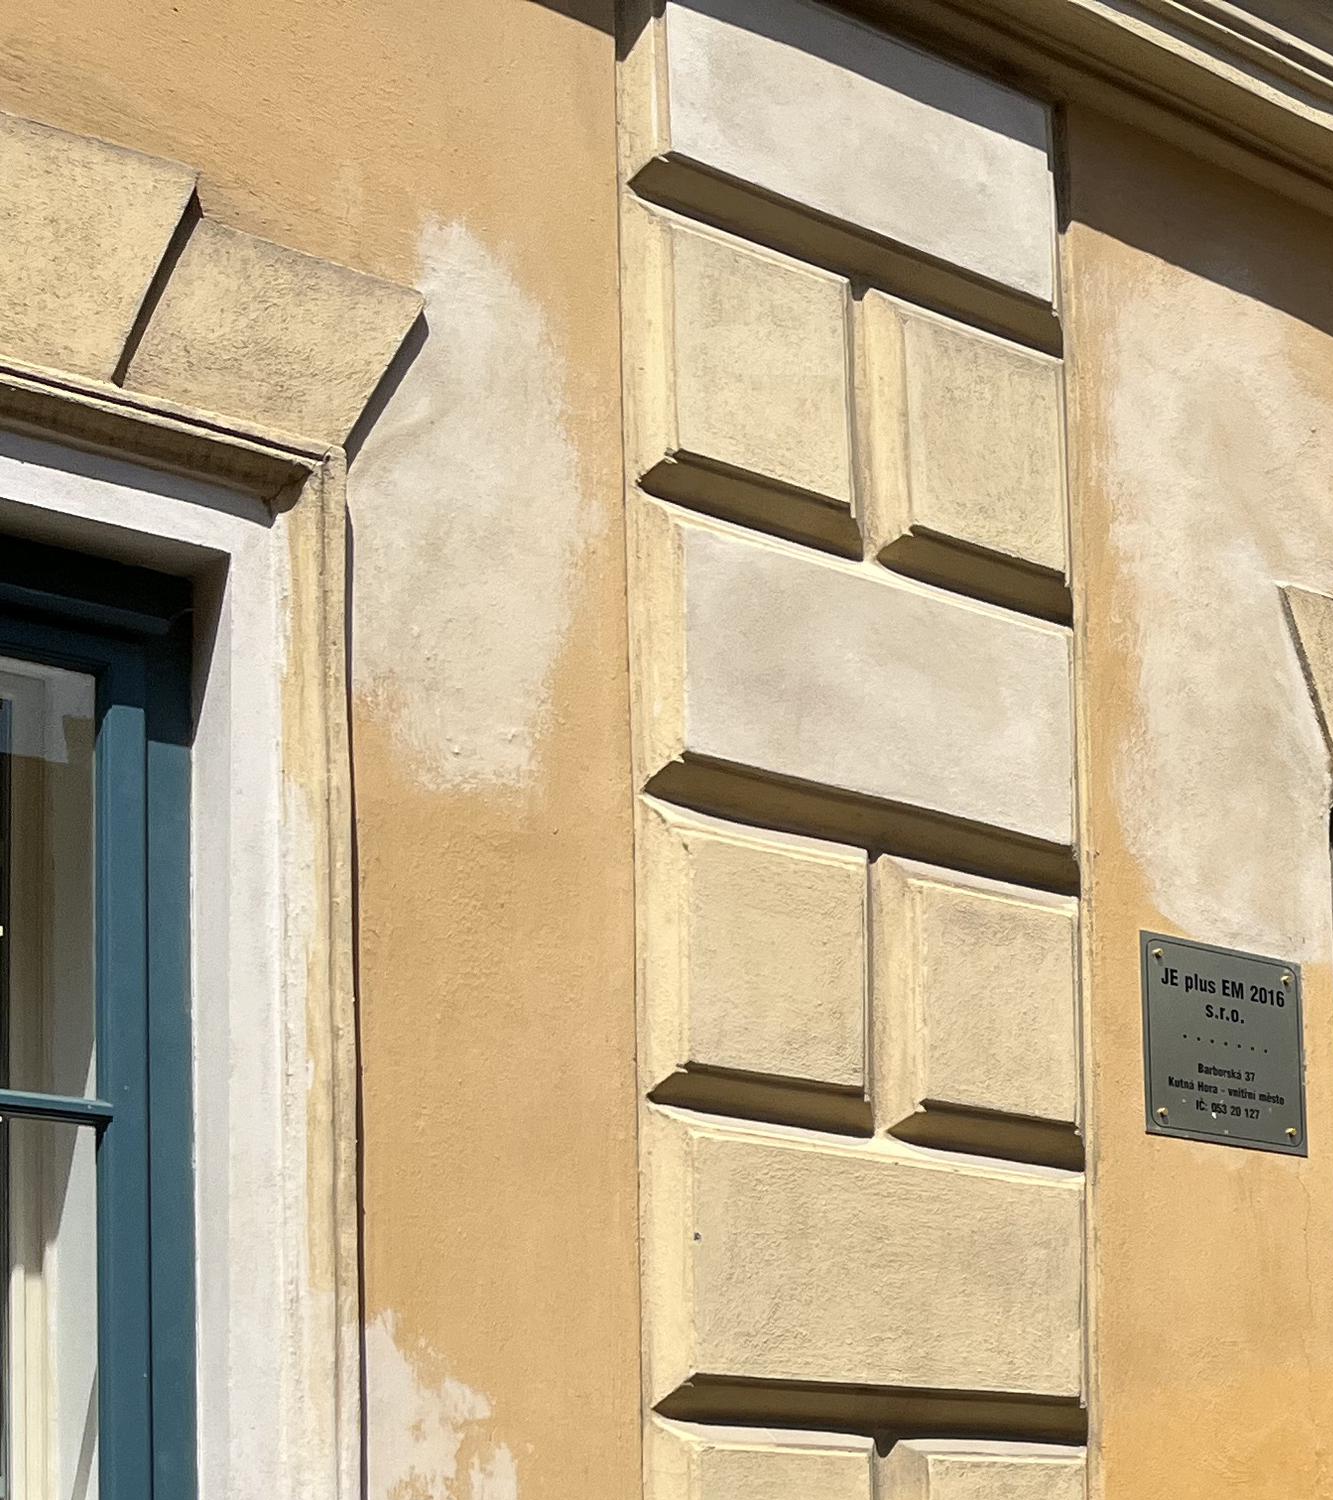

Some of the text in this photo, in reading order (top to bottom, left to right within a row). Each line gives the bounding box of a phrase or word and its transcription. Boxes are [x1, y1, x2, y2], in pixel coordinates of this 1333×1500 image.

[1161, 967, 1285, 1008] JE plus EM 2016
[1205, 1004, 1245, 1024] s.r.o.
[1197, 1063, 1256, 1082] Barborská 37
[1168, 1076, 1194, 1090] Kutná
[1197, 1081, 1218, 1094] Hora
[1211, 1102, 1227, 1115] 053
[1230, 1105, 1241, 1117] 20
[1244, 1108, 1260, 1120] 127
